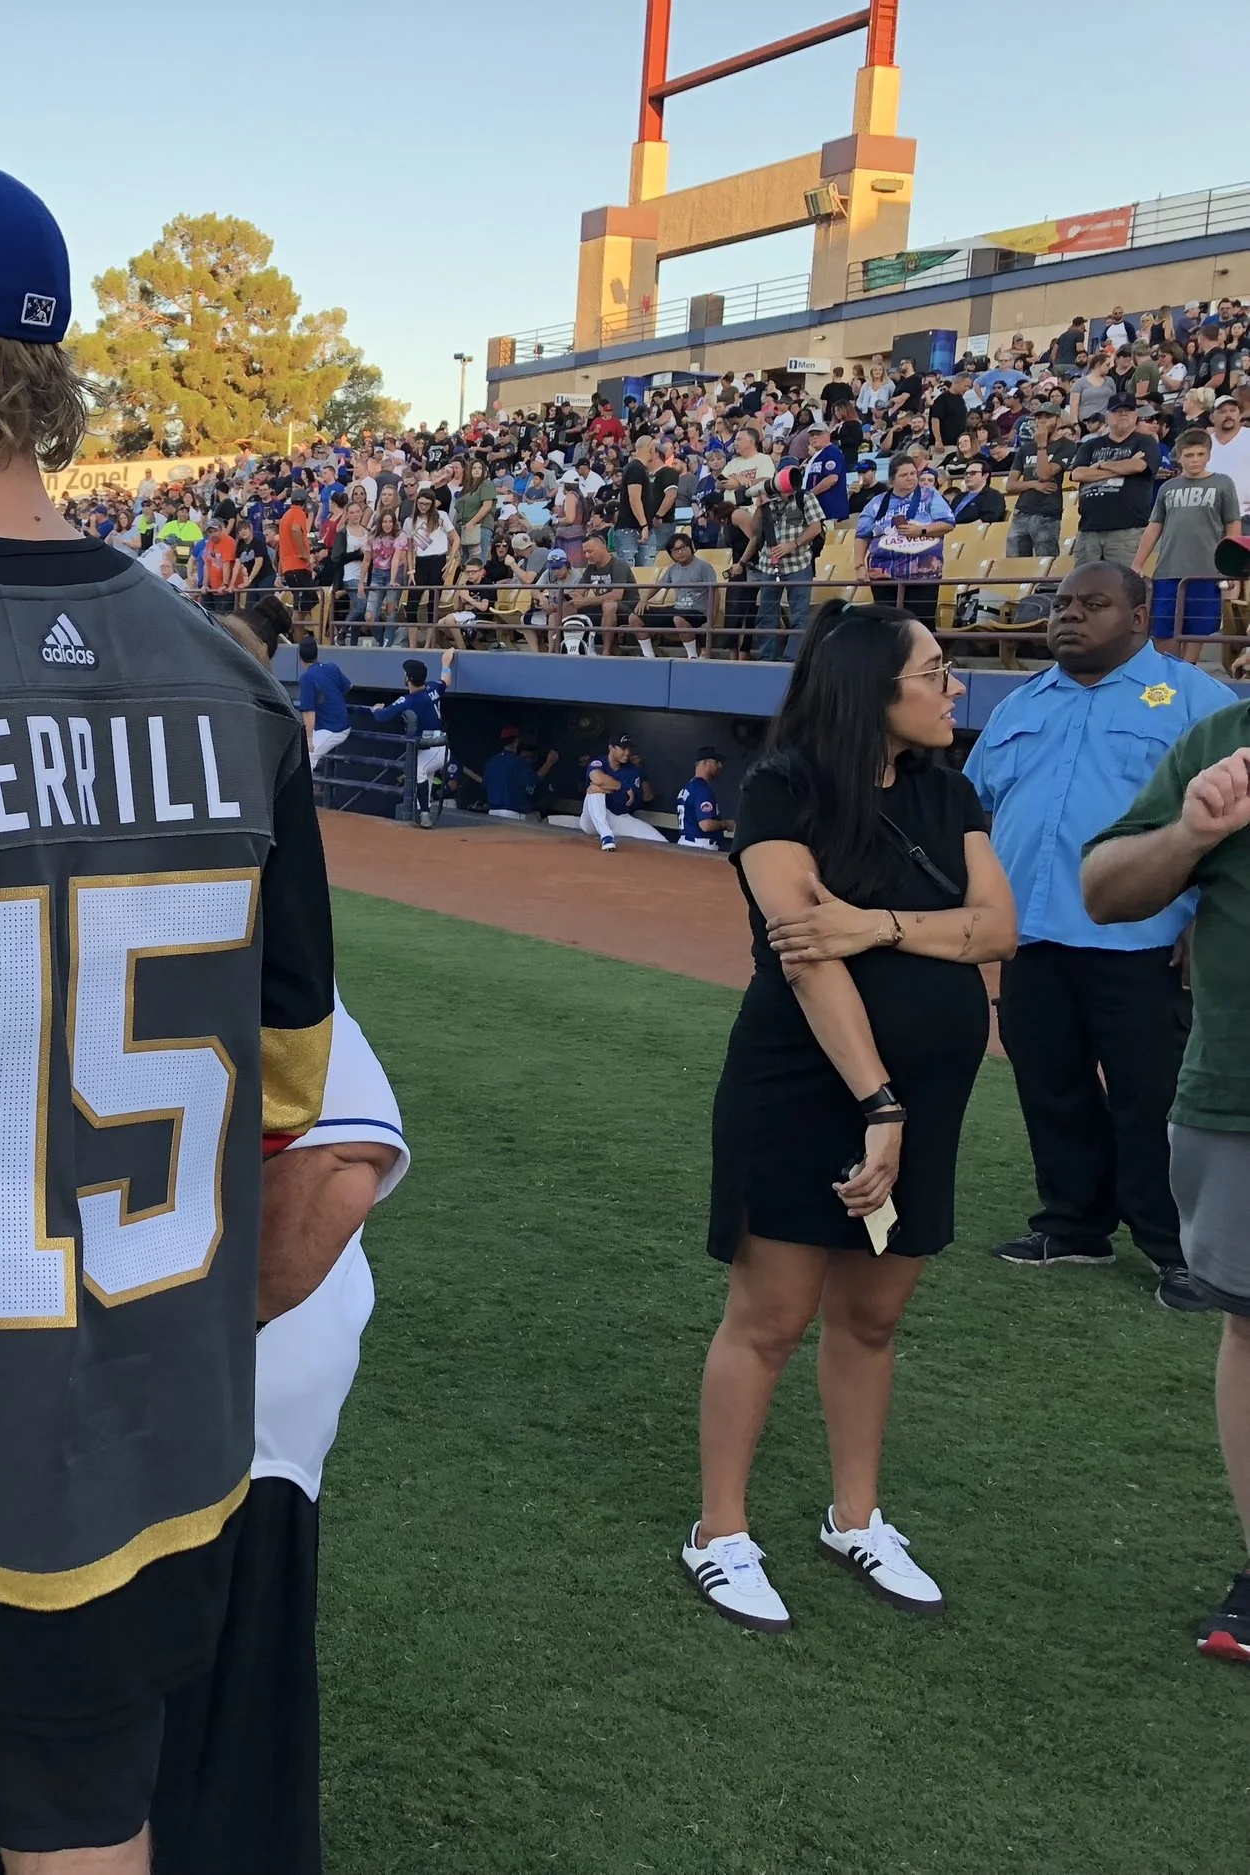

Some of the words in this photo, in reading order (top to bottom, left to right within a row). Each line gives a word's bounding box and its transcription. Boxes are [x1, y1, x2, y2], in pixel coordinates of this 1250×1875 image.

[65, 466, 129, 490] Zone!
[1175, 487, 1217, 507] NBA
[42, 644, 96, 665] adidas
